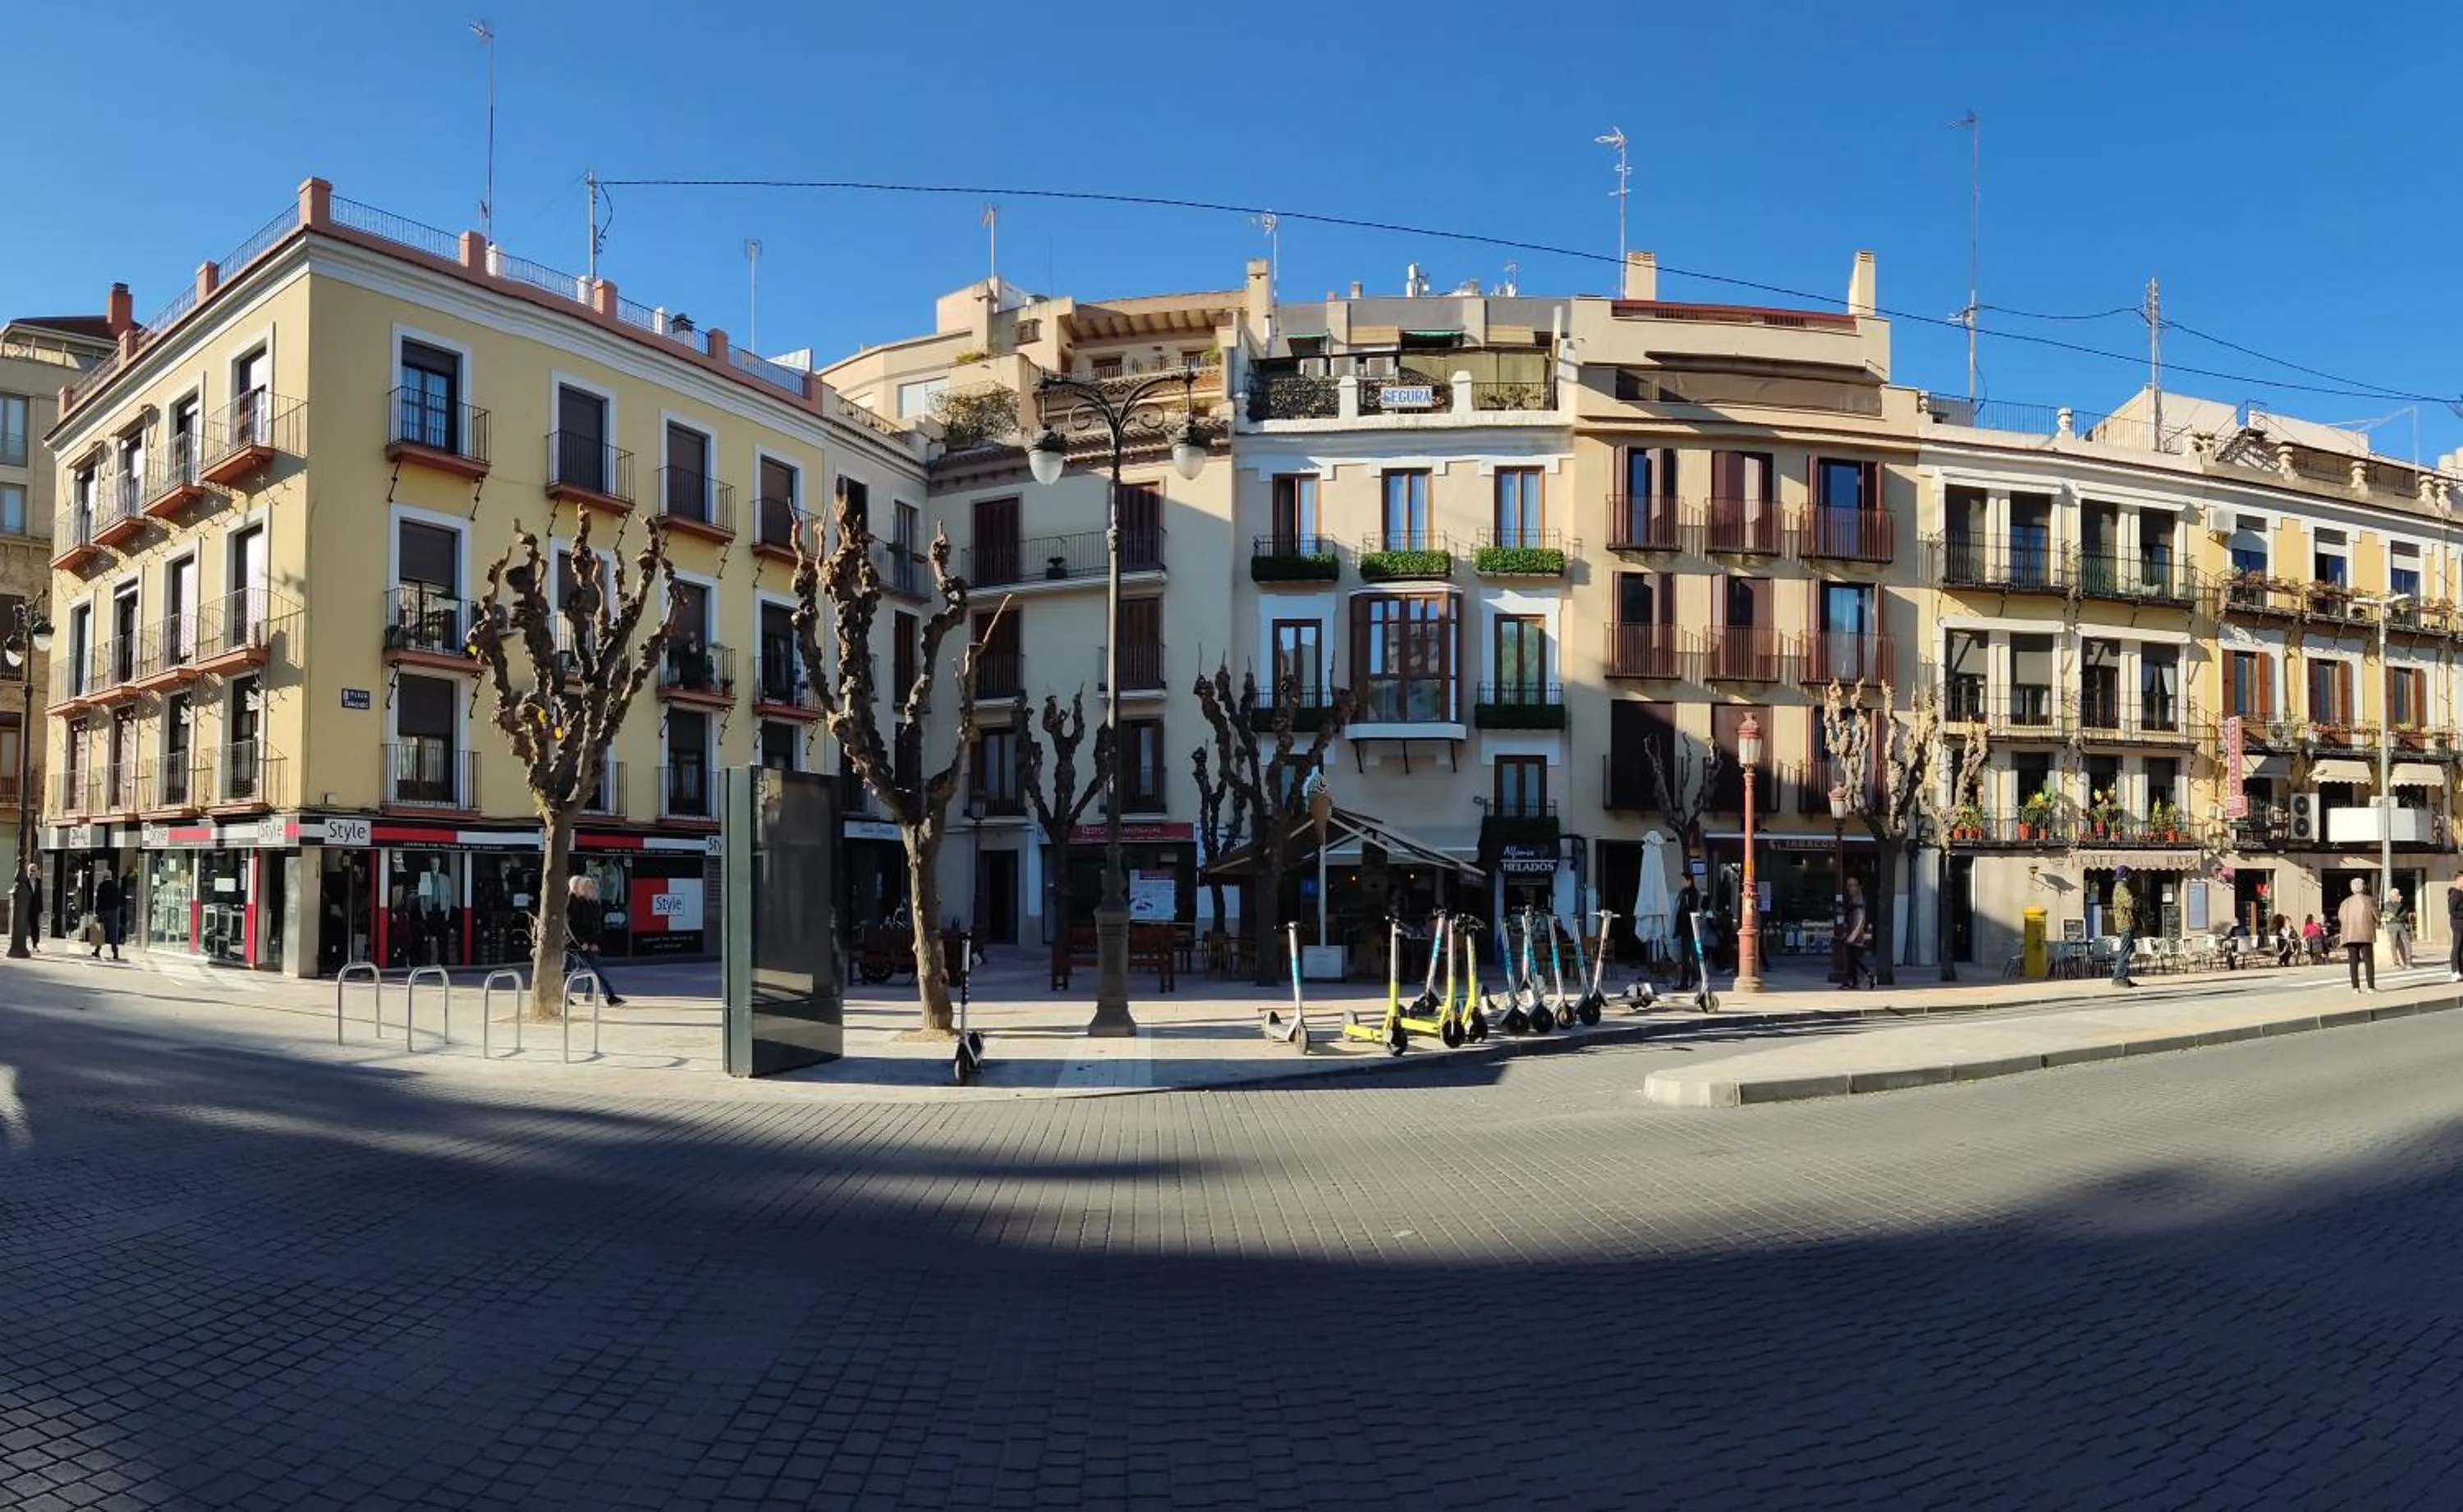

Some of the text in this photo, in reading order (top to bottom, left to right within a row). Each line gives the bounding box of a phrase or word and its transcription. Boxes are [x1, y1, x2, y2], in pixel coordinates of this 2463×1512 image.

[260, 822, 283, 841] Style
[329, 821, 367, 842] Style
[709, 836, 722, 853] Sty
[1503, 862, 1554, 872] HELADOS
[656, 896, 682, 913] Style
